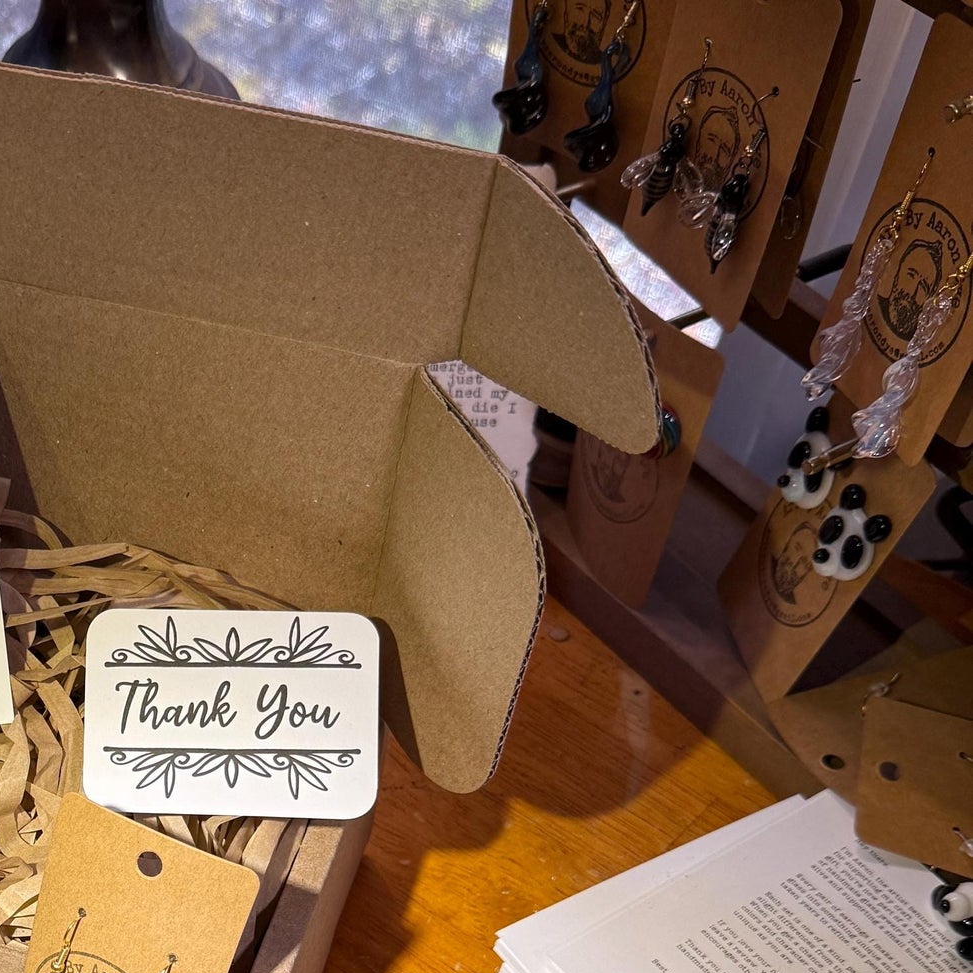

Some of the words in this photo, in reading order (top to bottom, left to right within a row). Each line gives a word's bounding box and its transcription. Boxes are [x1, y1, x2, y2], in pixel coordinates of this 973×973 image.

[720, 80, 757, 126] Aaron
[927, 212, 961, 265] Aaron
[447, 374, 483, 387] just
[471, 401, 499, 414] die
[507, 402, 517, 414] I
[490, 389, 509, 402] my
[115, 678, 238, 735] Thank
[254, 683, 341, 740] You
